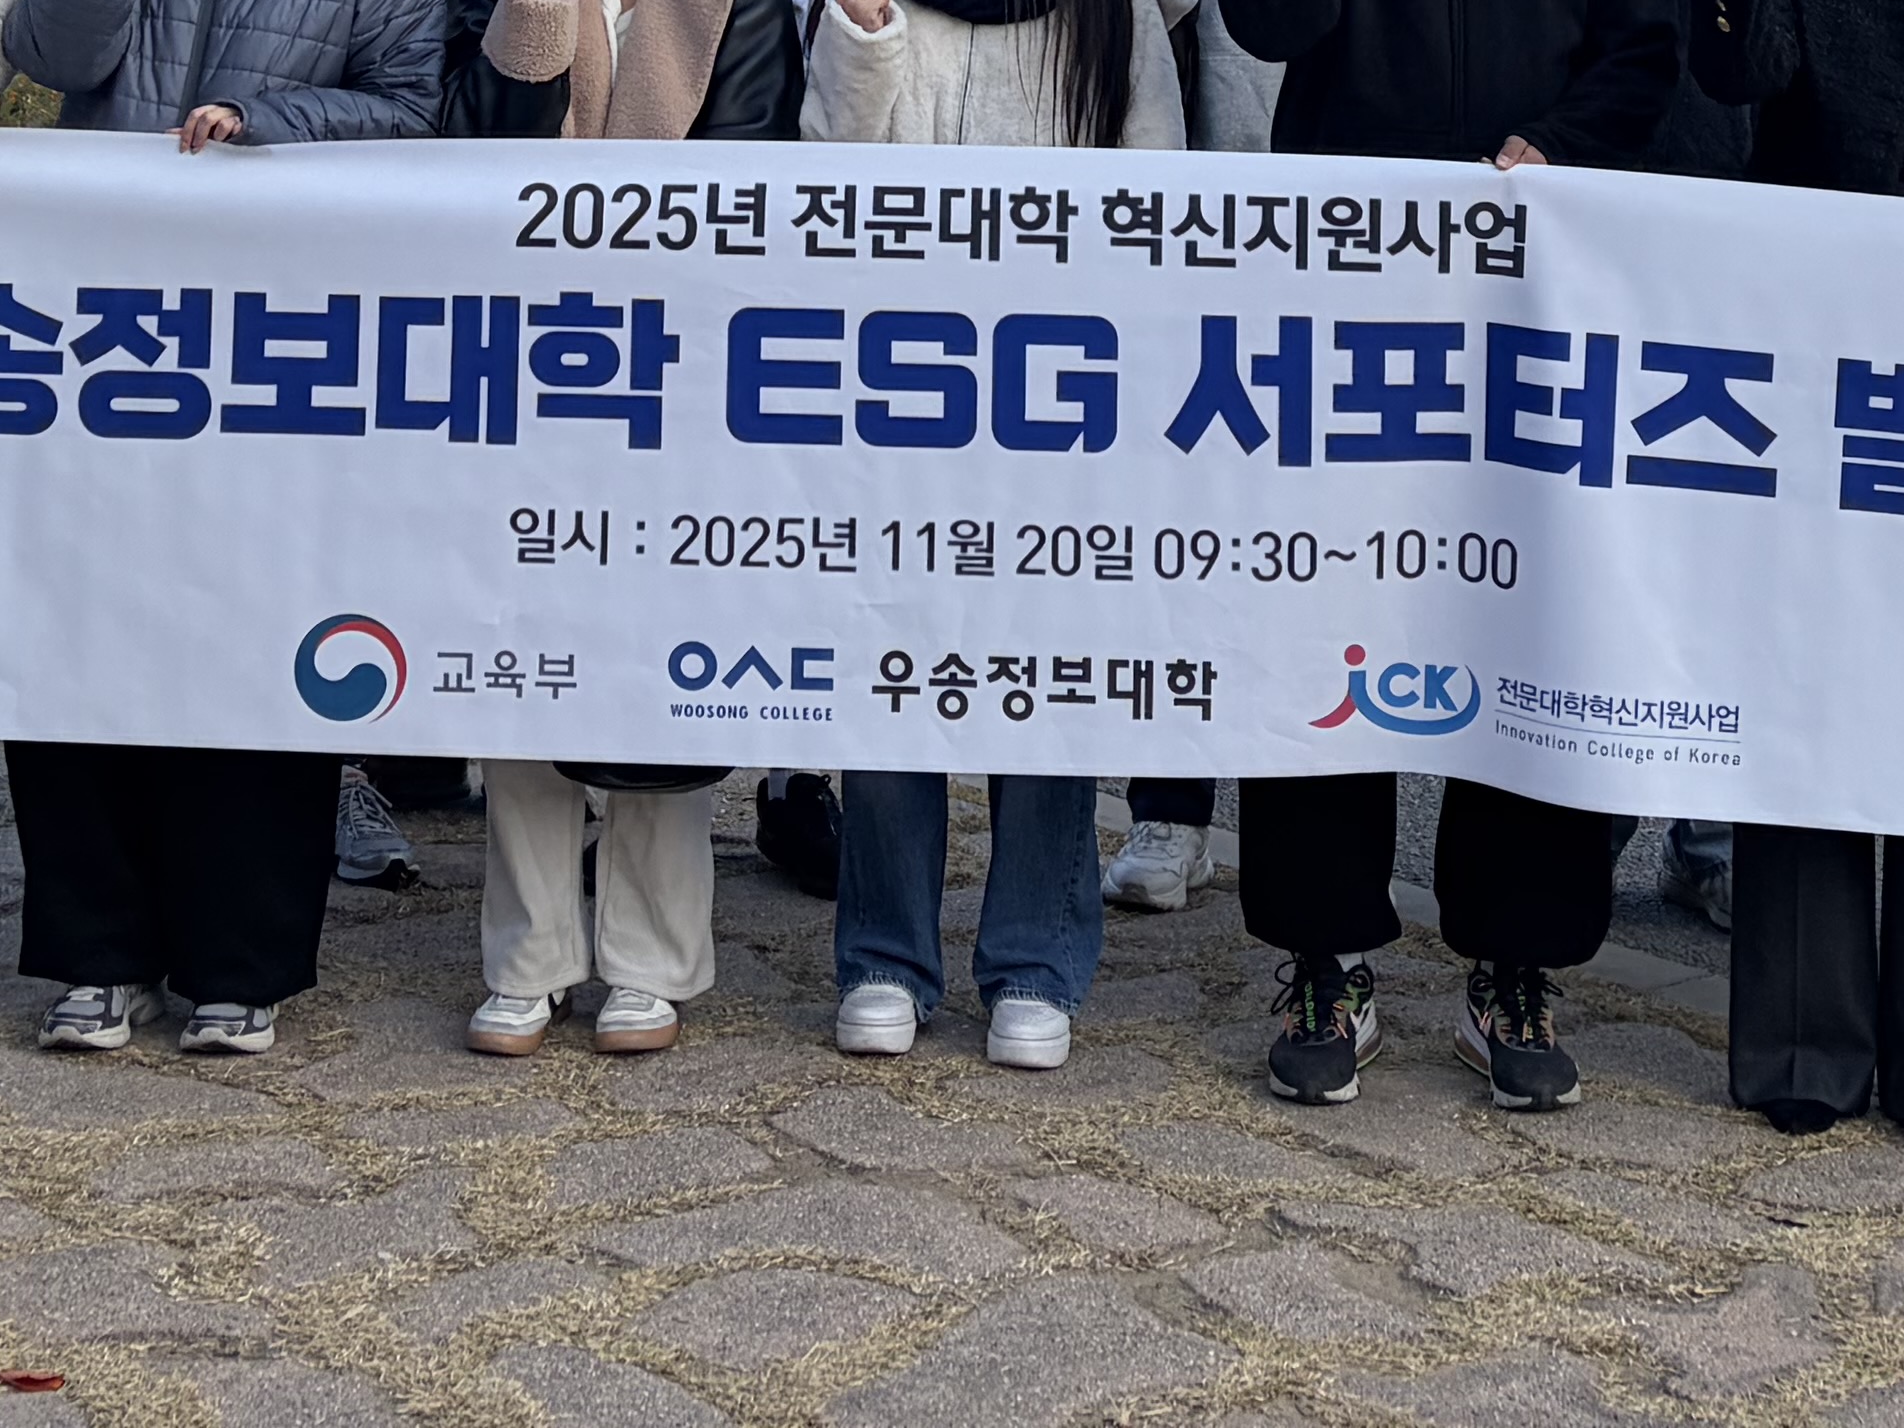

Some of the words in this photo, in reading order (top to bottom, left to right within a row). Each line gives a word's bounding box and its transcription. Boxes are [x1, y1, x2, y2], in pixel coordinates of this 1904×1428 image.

[515, 182, 768, 257] 2025년
[790, 183, 1080, 265] 전문대학
[1100, 187, 1528, 280] 혁신지원사업
[725, 306, 1119, 454] ESG
[1163, 314, 1779, 499] 서포터즈
[509, 507, 610, 567] 일시
[669, 513, 858, 574] 2025년
[881, 519, 996, 578] 11월
[1015, 523, 1134, 582] 20일
[1153, 527, 1519, 590] 09:30~10:00
[432, 649, 578, 700] 교육부
[871, 649, 1219, 722] 우송정보대학
[1496, 676, 1740, 734] 전문대학혁신지원사업
[669, 703, 749, 720] WOOSONG
[759, 705, 833, 722] COLLEGE
[1496, 719, 1577, 753] Innovation
[1587, 740, 1655, 765] College
[1663, 746, 1680, 762] of
[1688, 748, 1742, 766] Korea
